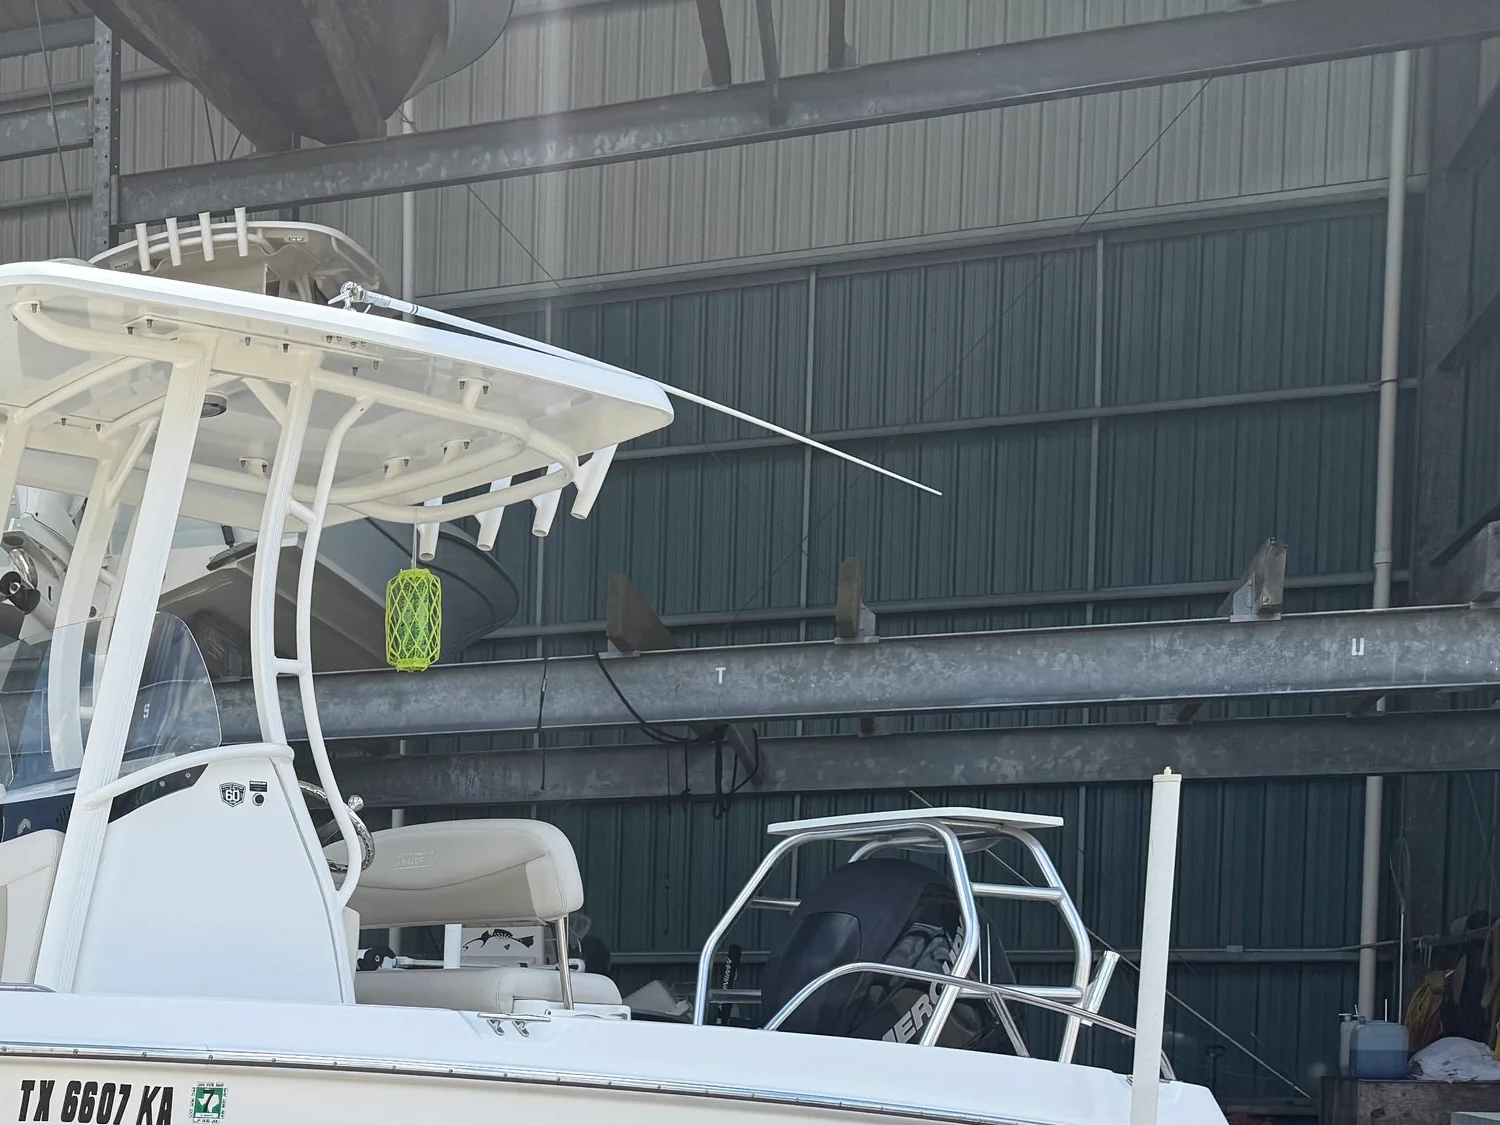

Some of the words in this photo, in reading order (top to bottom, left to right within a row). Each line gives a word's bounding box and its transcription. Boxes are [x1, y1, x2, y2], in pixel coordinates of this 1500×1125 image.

[1351, 637, 1365, 656] U
[715, 666, 726, 684] T
[143, 703, 150, 719] S
[225, 789, 240, 801] 60
[18, 1079, 56, 1122] TX
[60, 1080, 132, 1125] 6607
[202, 1089, 215, 1113] 7
